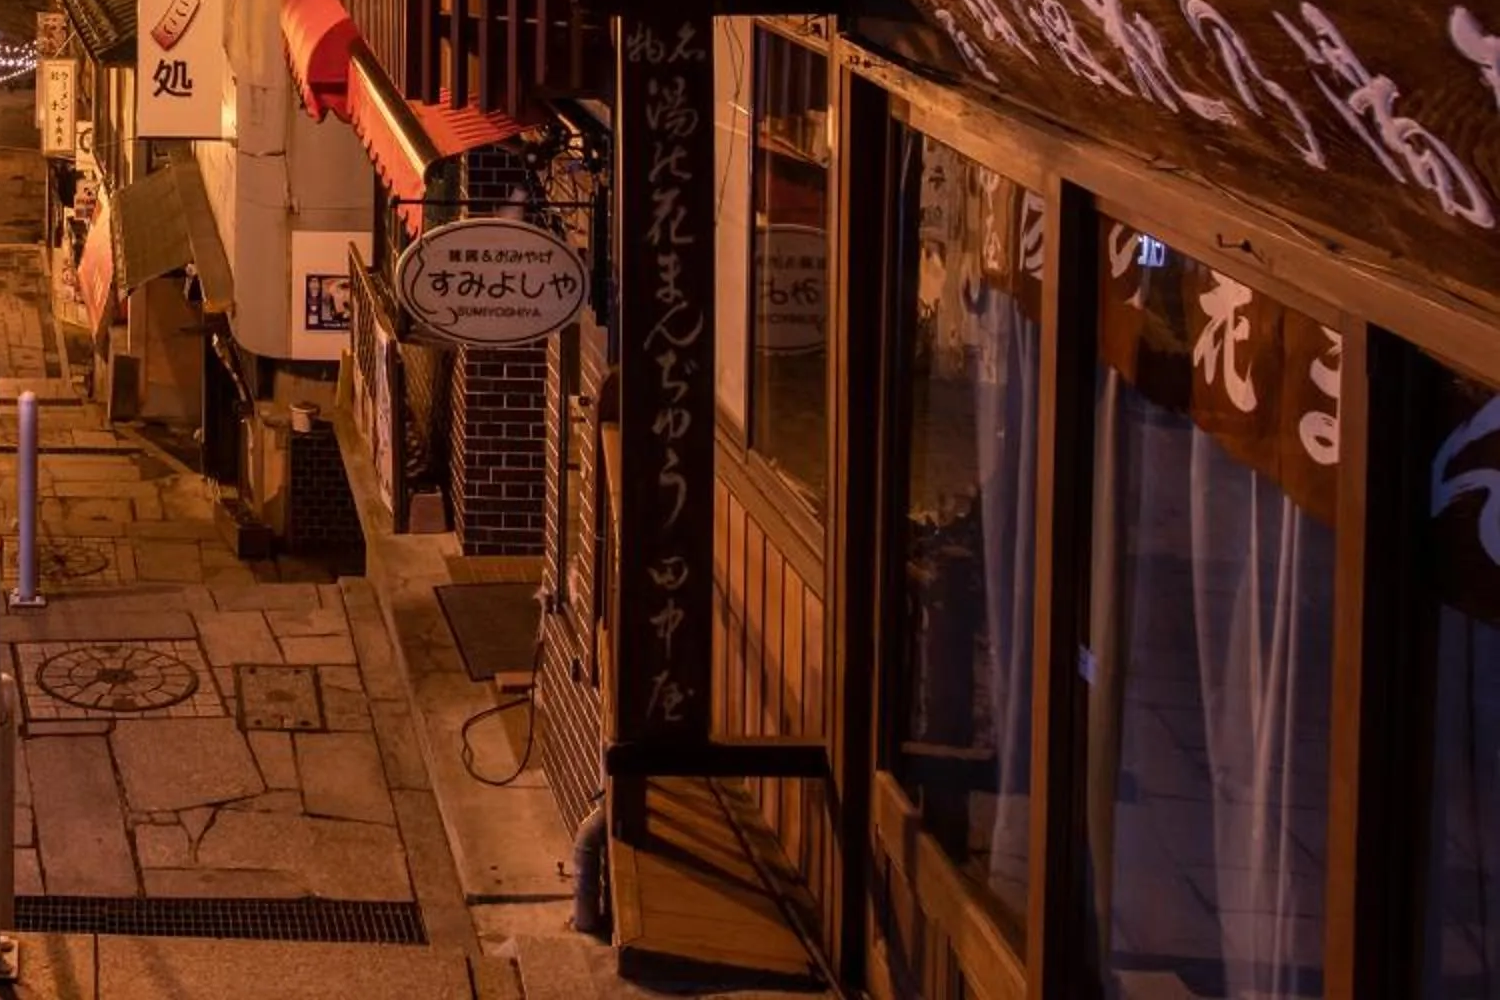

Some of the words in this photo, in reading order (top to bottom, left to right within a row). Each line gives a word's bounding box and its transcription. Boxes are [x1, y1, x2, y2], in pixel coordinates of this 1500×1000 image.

[428, 269, 577, 301] すみよしや
